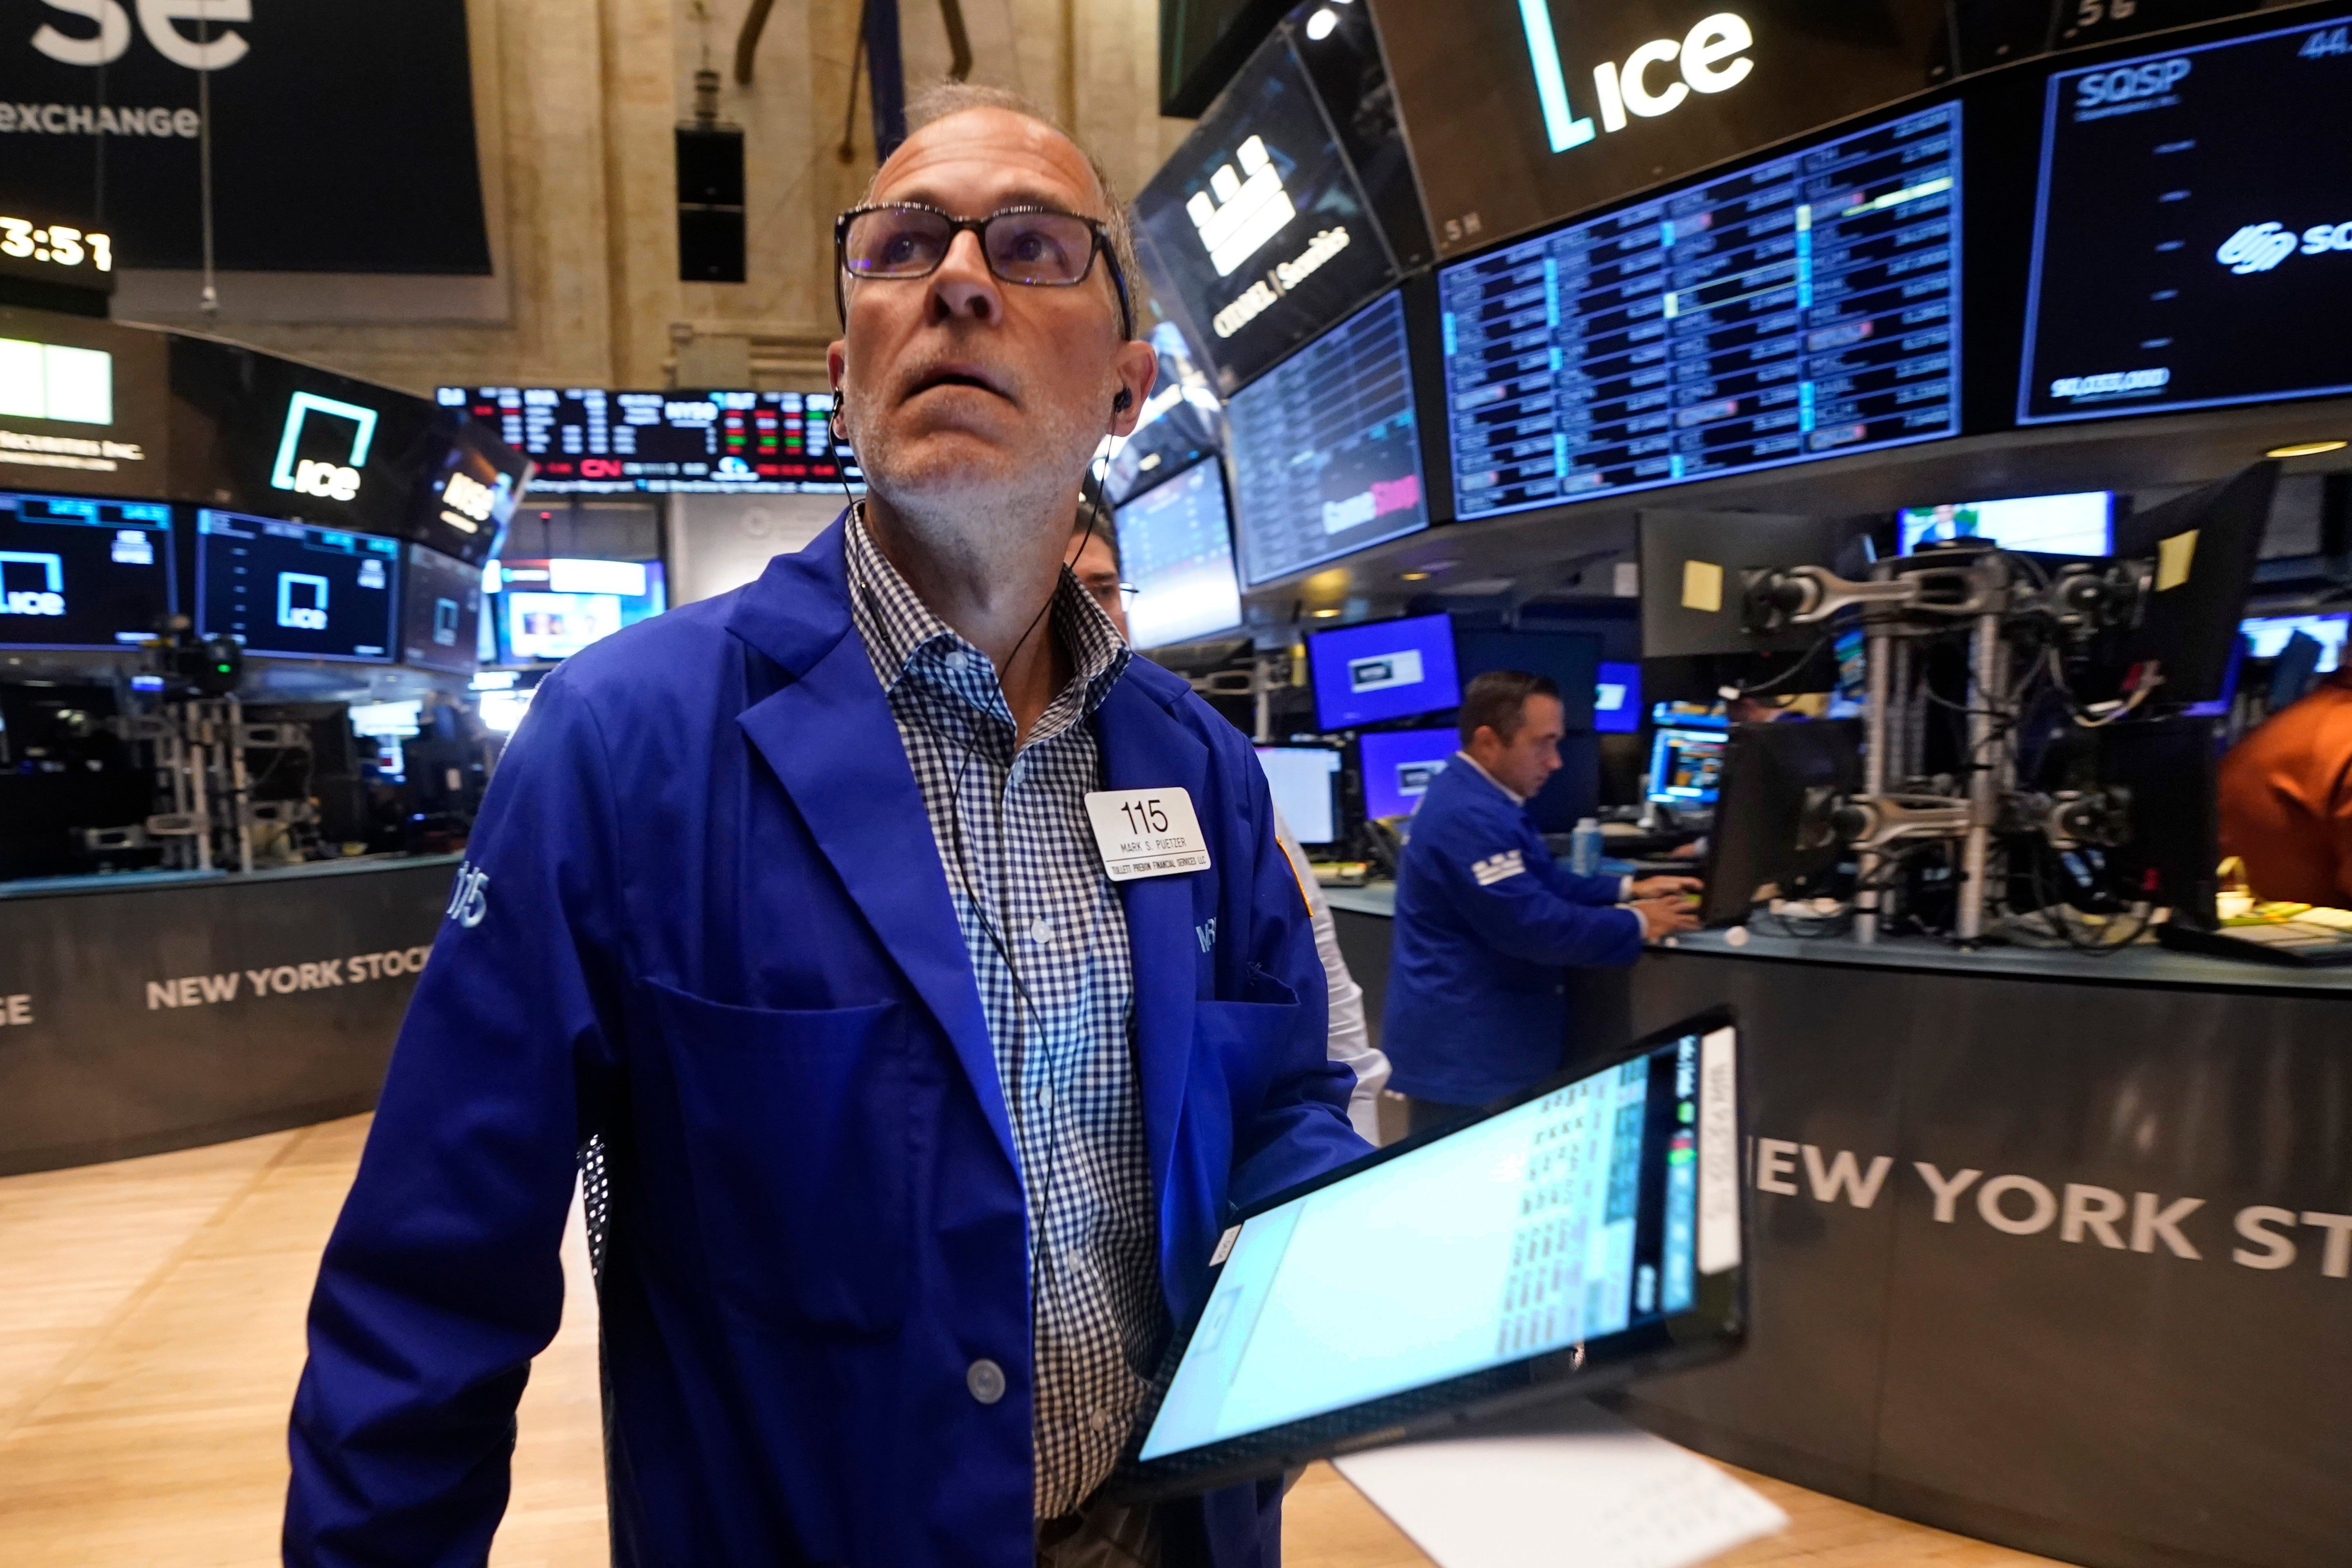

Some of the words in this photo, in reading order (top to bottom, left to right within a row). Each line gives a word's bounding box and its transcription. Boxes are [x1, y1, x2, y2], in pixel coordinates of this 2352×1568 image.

[1121, 799, 1168, 835] 115
[1120, 842, 1143, 853] MARK
[1146, 841, 1154, 851] S.
[1156, 837, 1187, 849] PUETZER
[1177, 857, 1196, 867] SERVICES
[1197, 855, 1206, 864] LLC
[147, 971, 240, 1011] NEW
[246, 958, 343, 997] YORK
[347, 945, 434, 984] STOC
[1747, 1136, 1893, 1209] EW
[1913, 1160, 2207, 1261] YORK
